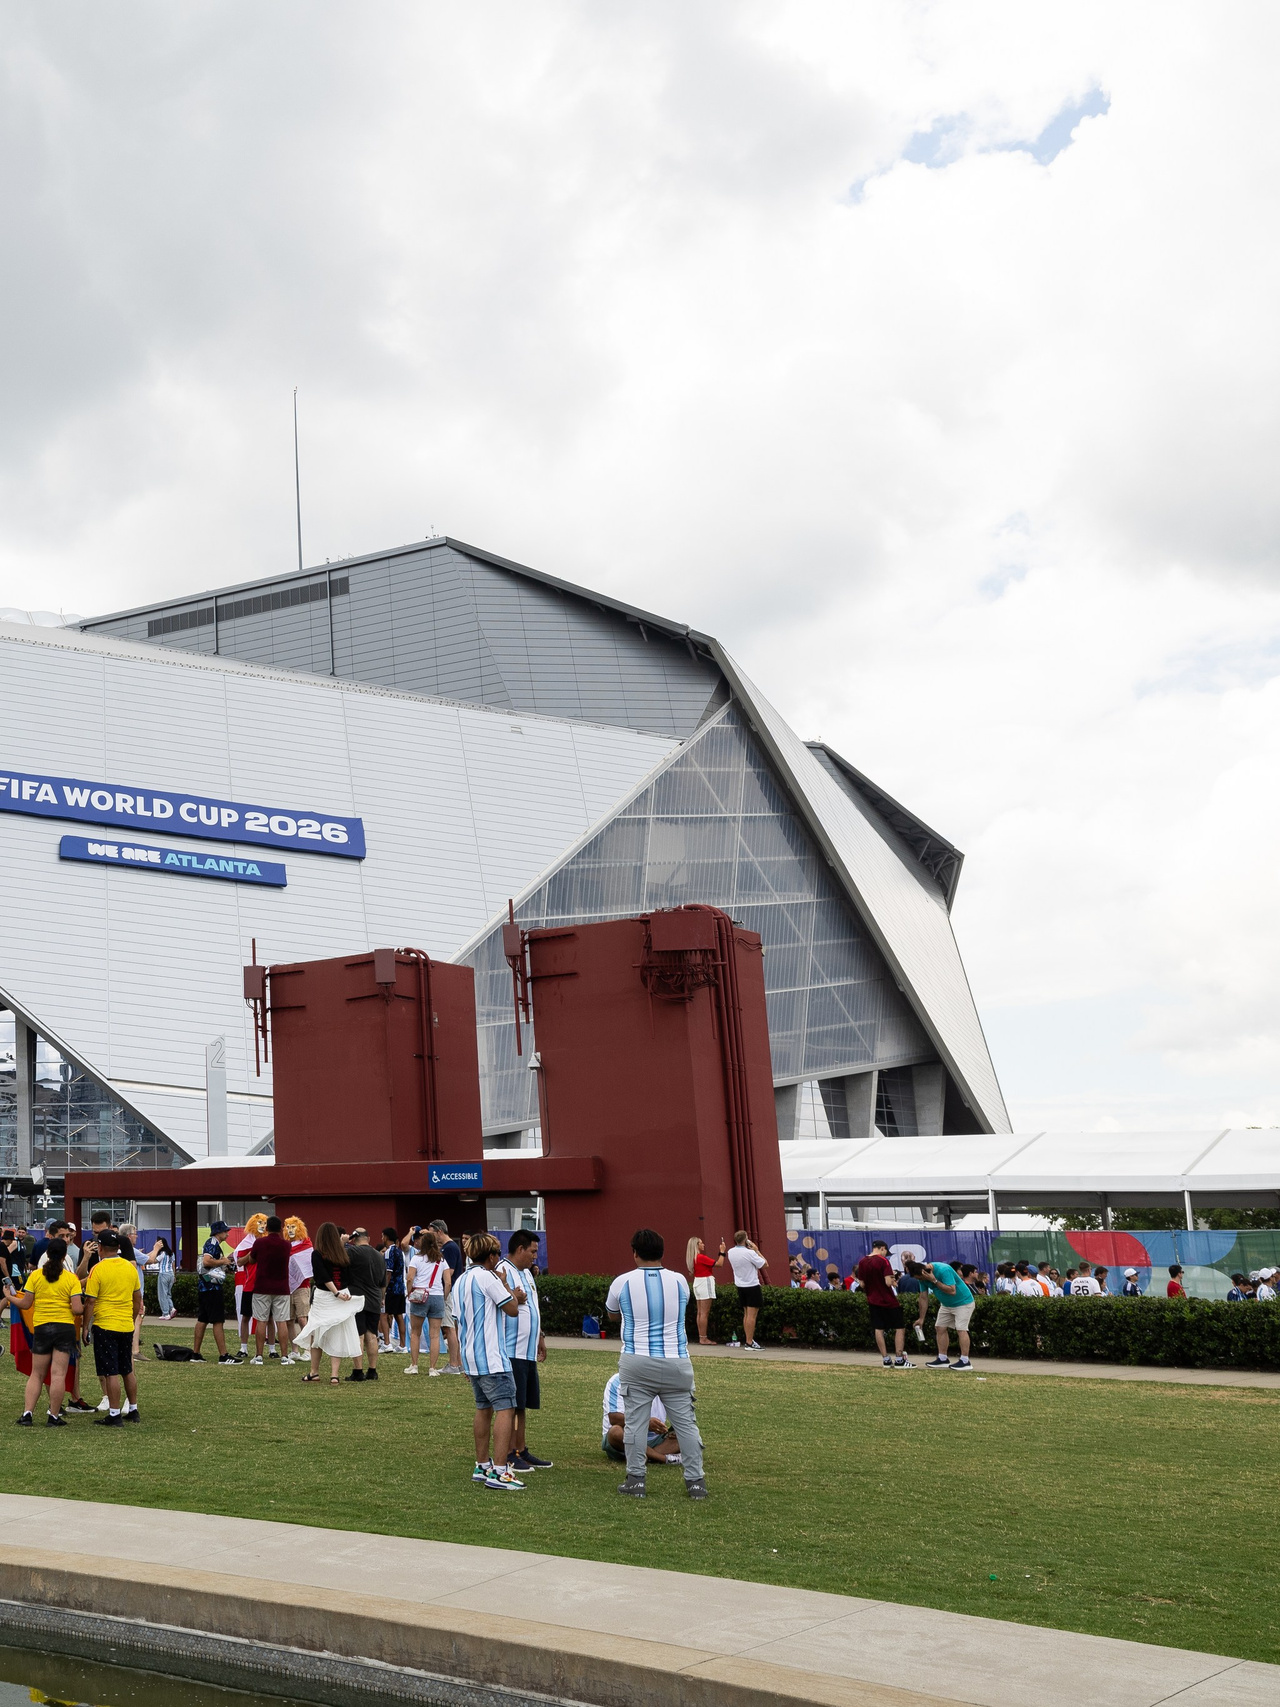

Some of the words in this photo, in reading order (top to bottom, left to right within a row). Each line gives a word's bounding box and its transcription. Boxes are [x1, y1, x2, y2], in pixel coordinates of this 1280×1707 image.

[62, 786, 173, 819] WORLD
[179, 802, 239, 827] CUP
[245, 811, 349, 844] 2026
[87, 842, 119, 858] WE
[121, 846, 161, 864] ARE
[164, 853, 263, 876] ATLANTA
[441, 1172, 478, 1180] ACCESSIBLE
[1074, 1285, 1090, 1296] 26
